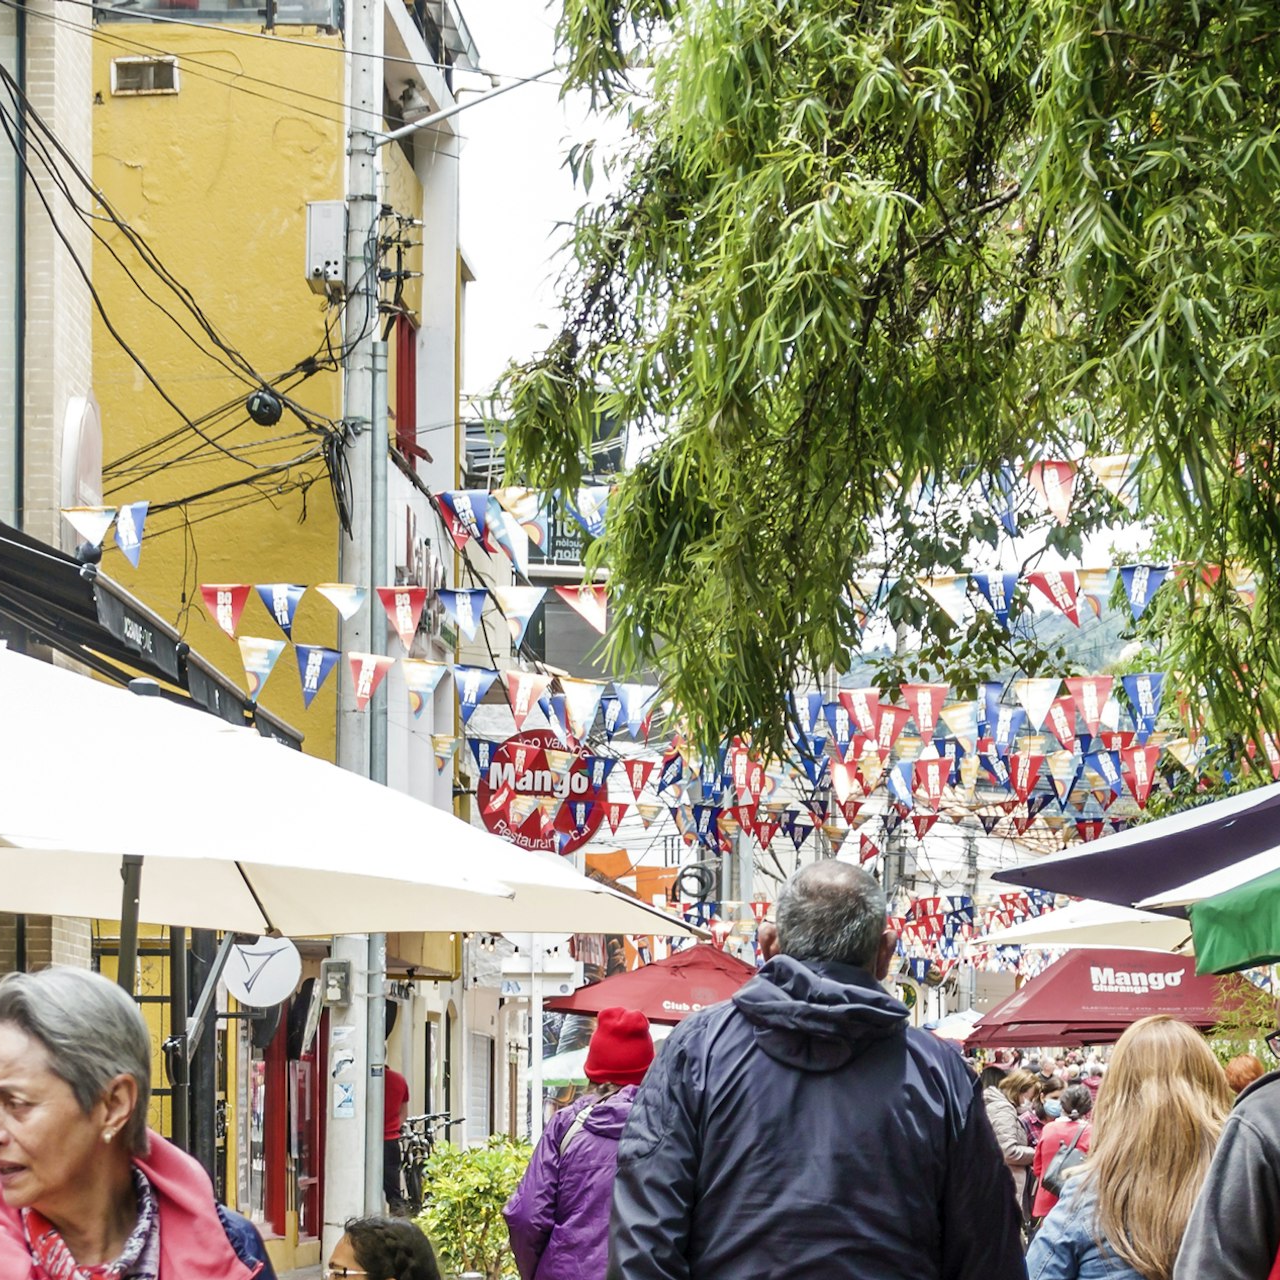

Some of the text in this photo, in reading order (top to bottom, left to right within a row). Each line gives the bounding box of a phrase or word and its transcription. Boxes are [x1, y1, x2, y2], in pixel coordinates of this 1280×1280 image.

[489, 762, 589, 799] Mango
[1089, 966, 1185, 990] Mango
[1092, 984, 1149, 994] charanga
[662, 1000, 690, 1011] Club
